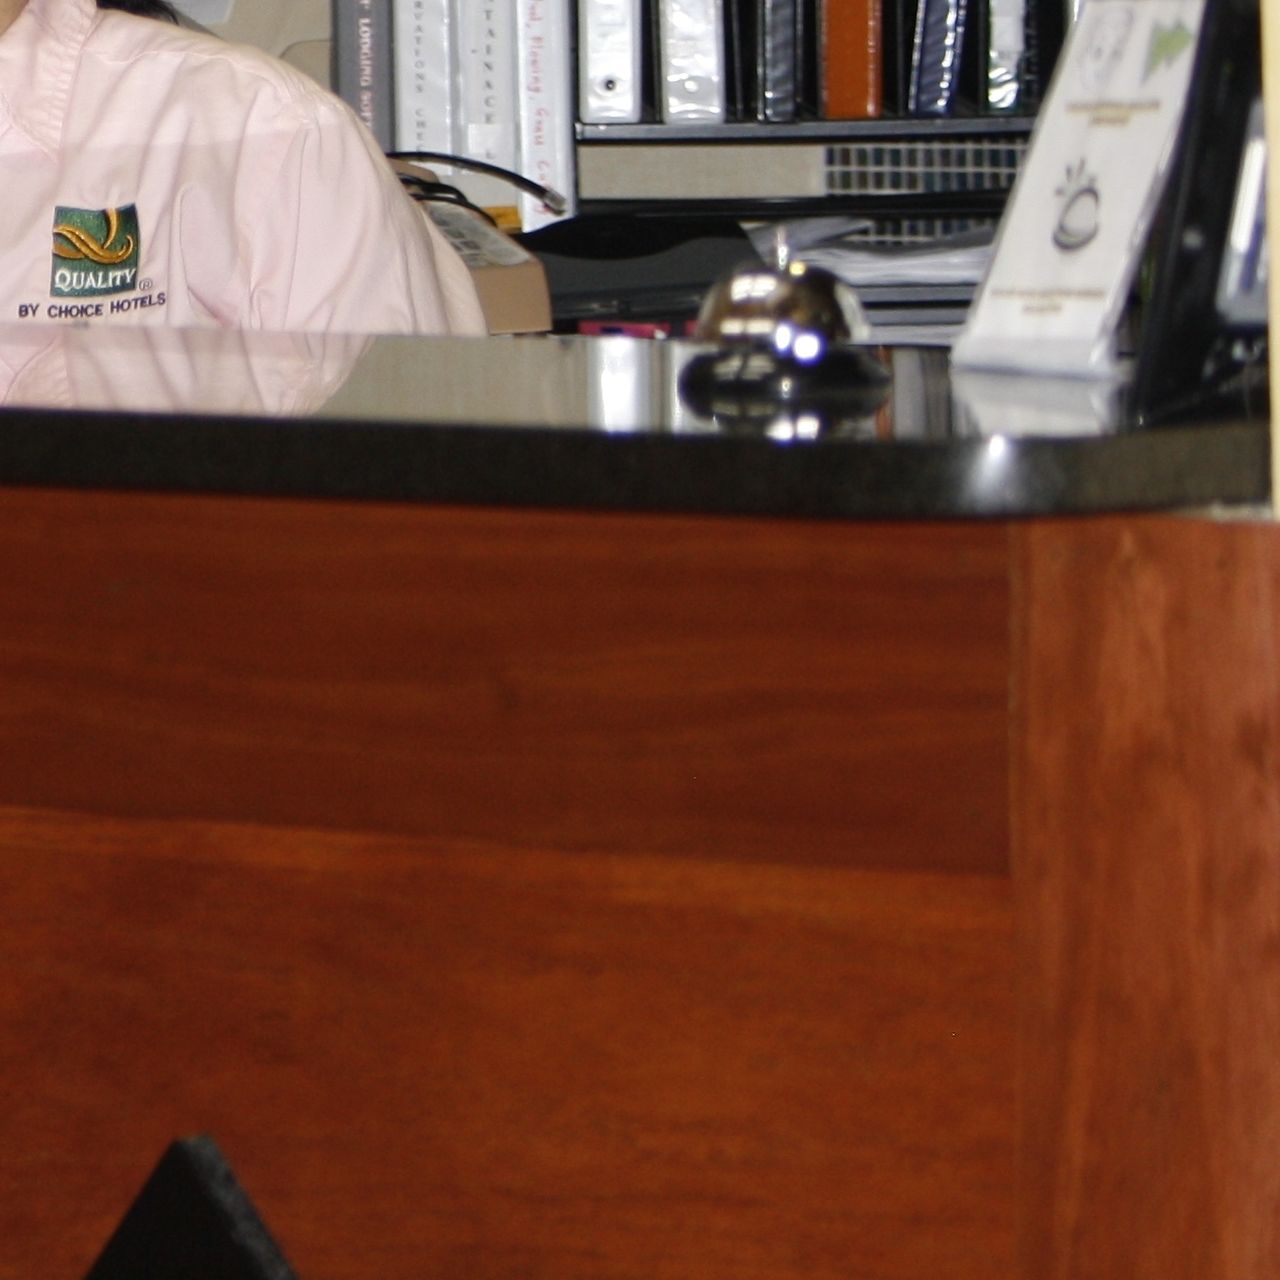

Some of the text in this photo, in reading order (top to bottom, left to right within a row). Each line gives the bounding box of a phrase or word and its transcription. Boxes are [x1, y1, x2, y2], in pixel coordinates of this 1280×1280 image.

[54, 267, 136, 292] QUALITY
[18, 292, 167, 319] BY CHOICE HOTELS
